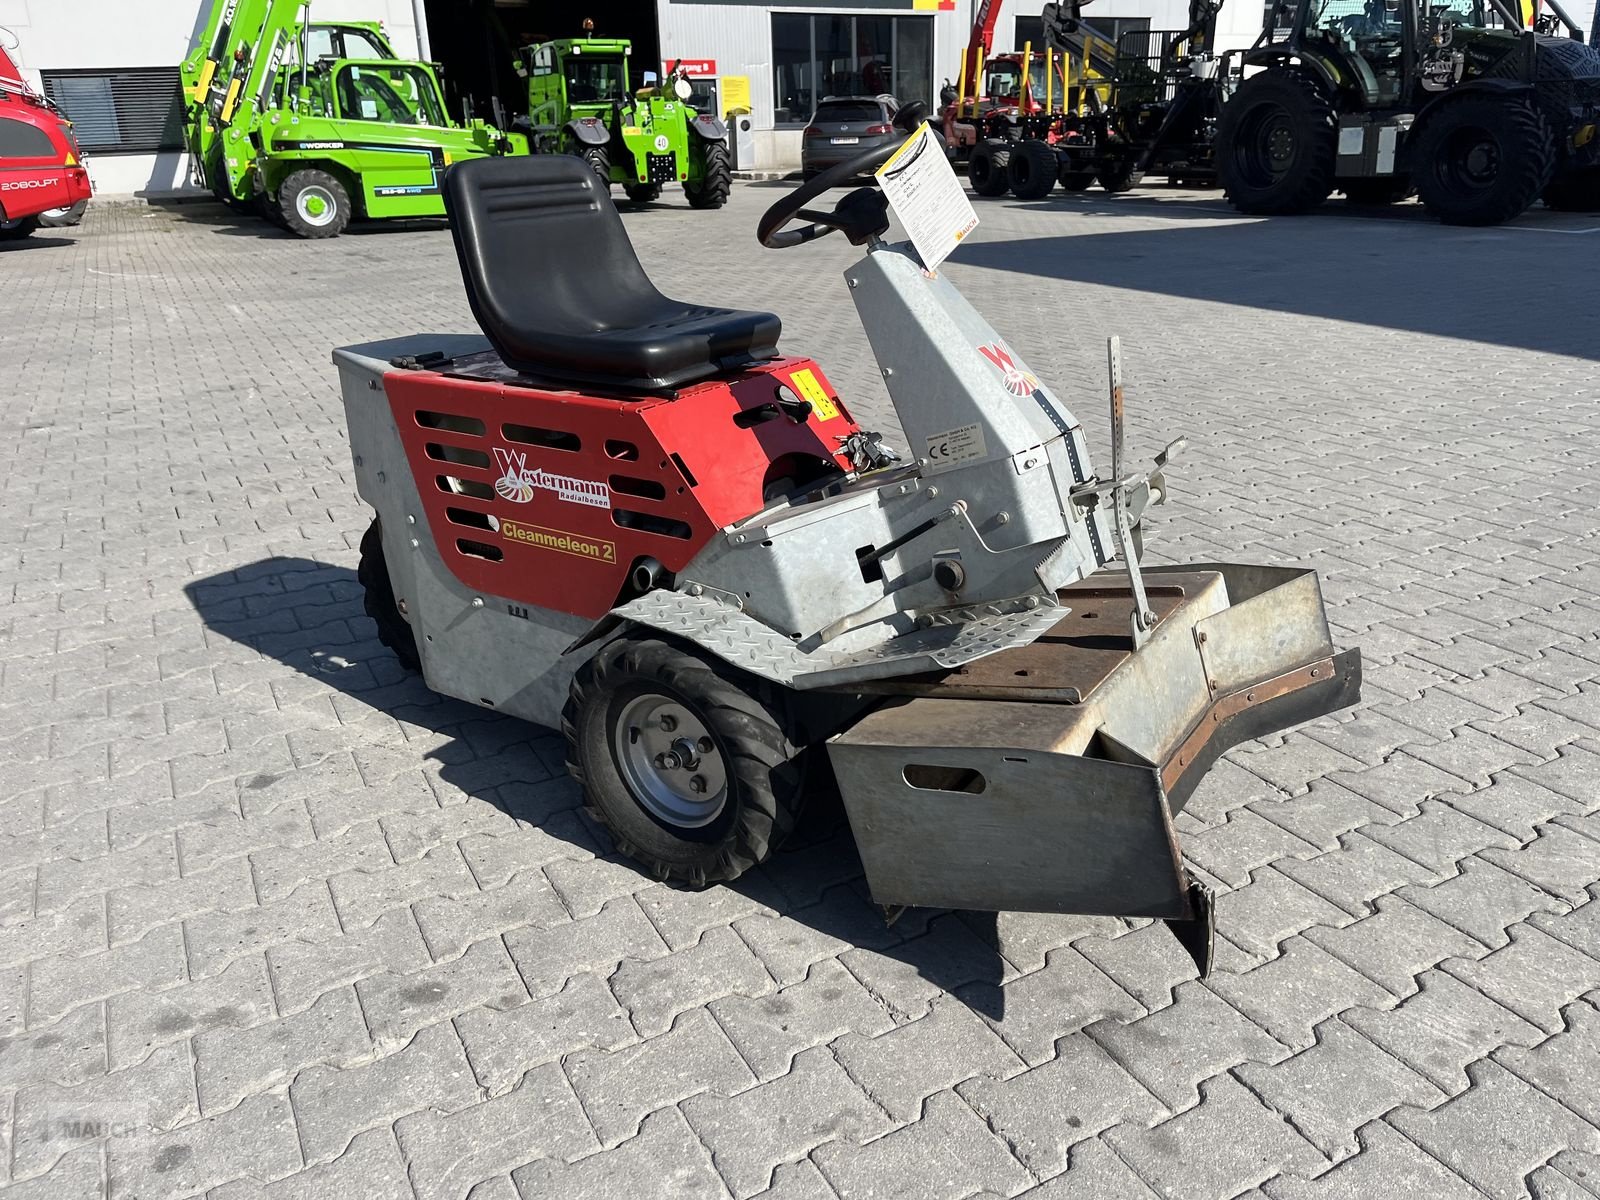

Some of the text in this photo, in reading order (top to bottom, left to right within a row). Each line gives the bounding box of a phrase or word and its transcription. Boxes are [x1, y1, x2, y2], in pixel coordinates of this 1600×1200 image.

[657, 138, 666, 148] 40
[1, 178, 58, 191] 2080LPT
[956, 218, 977, 241] MAUCH
[492, 447, 608, 498] Westermann
[560, 492, 609, 507] Radialbesen
[502, 522, 613, 560] Cleanmeleon 2
